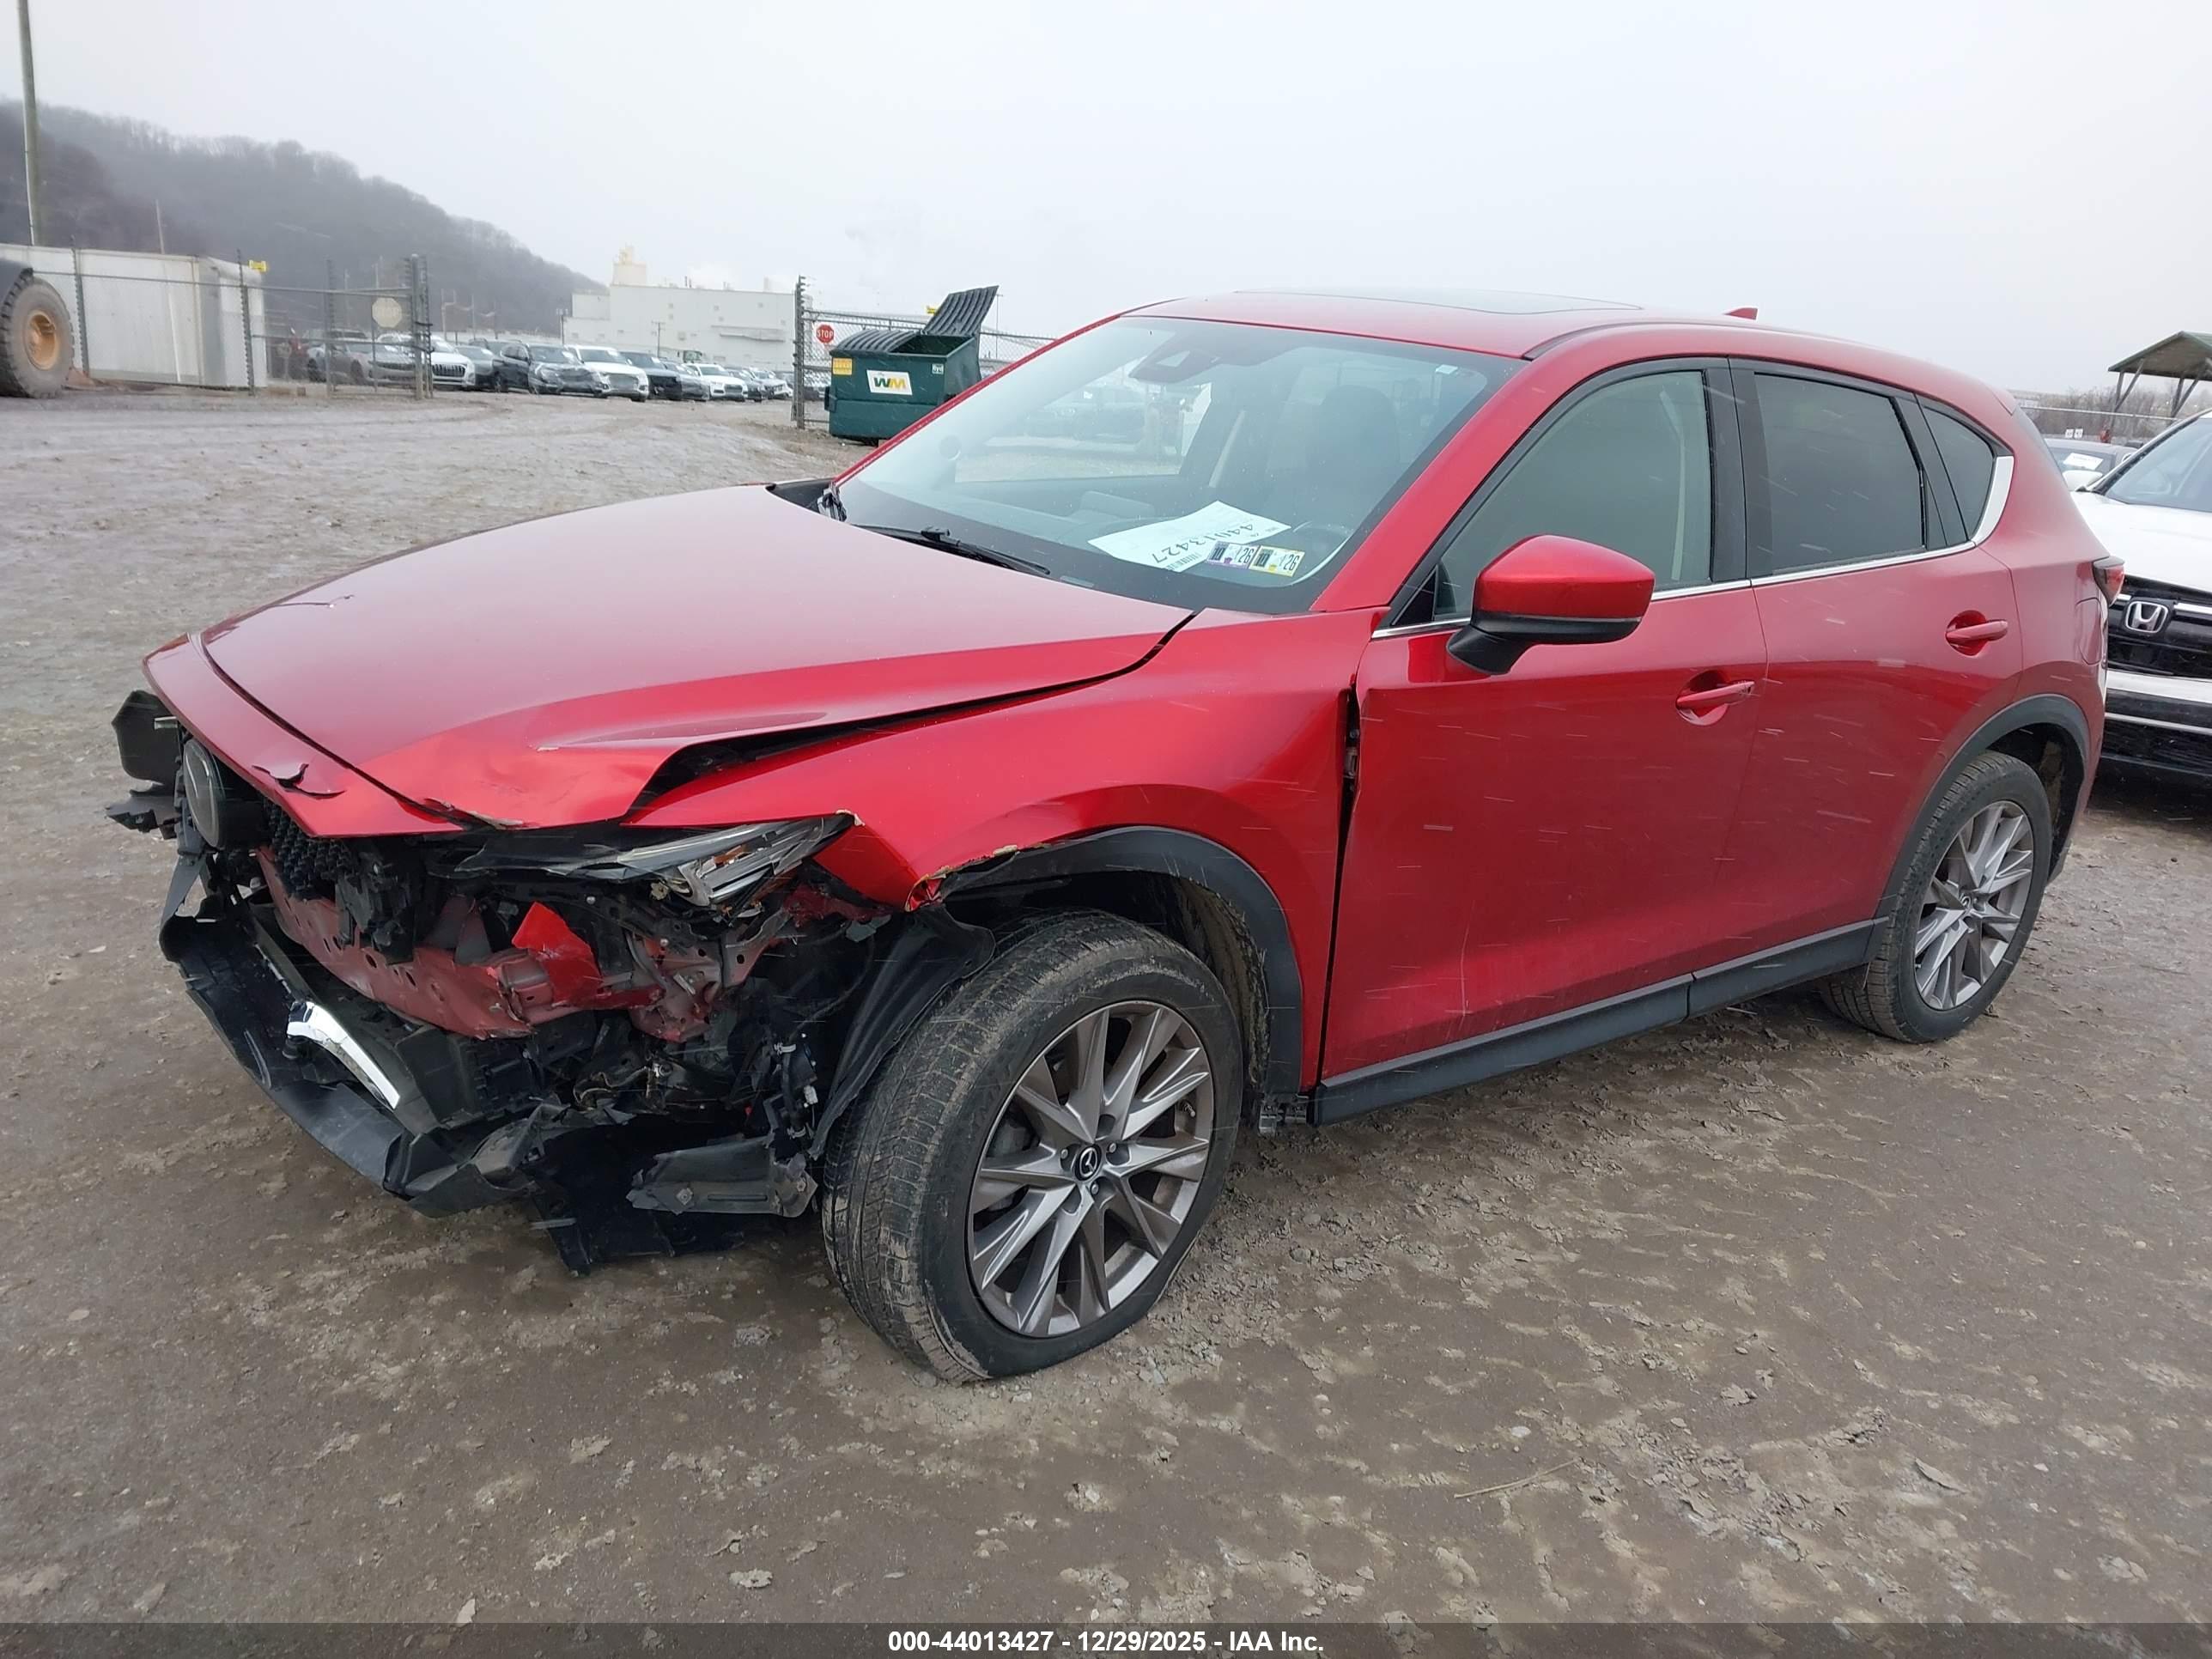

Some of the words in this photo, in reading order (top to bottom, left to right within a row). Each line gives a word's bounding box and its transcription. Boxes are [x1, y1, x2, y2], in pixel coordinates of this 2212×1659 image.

[817, 329, 834, 339] STOP
[873, 377, 907, 389] WM
[1238, 548, 1255, 564] 26
[1283, 554, 1299, 571] 26
